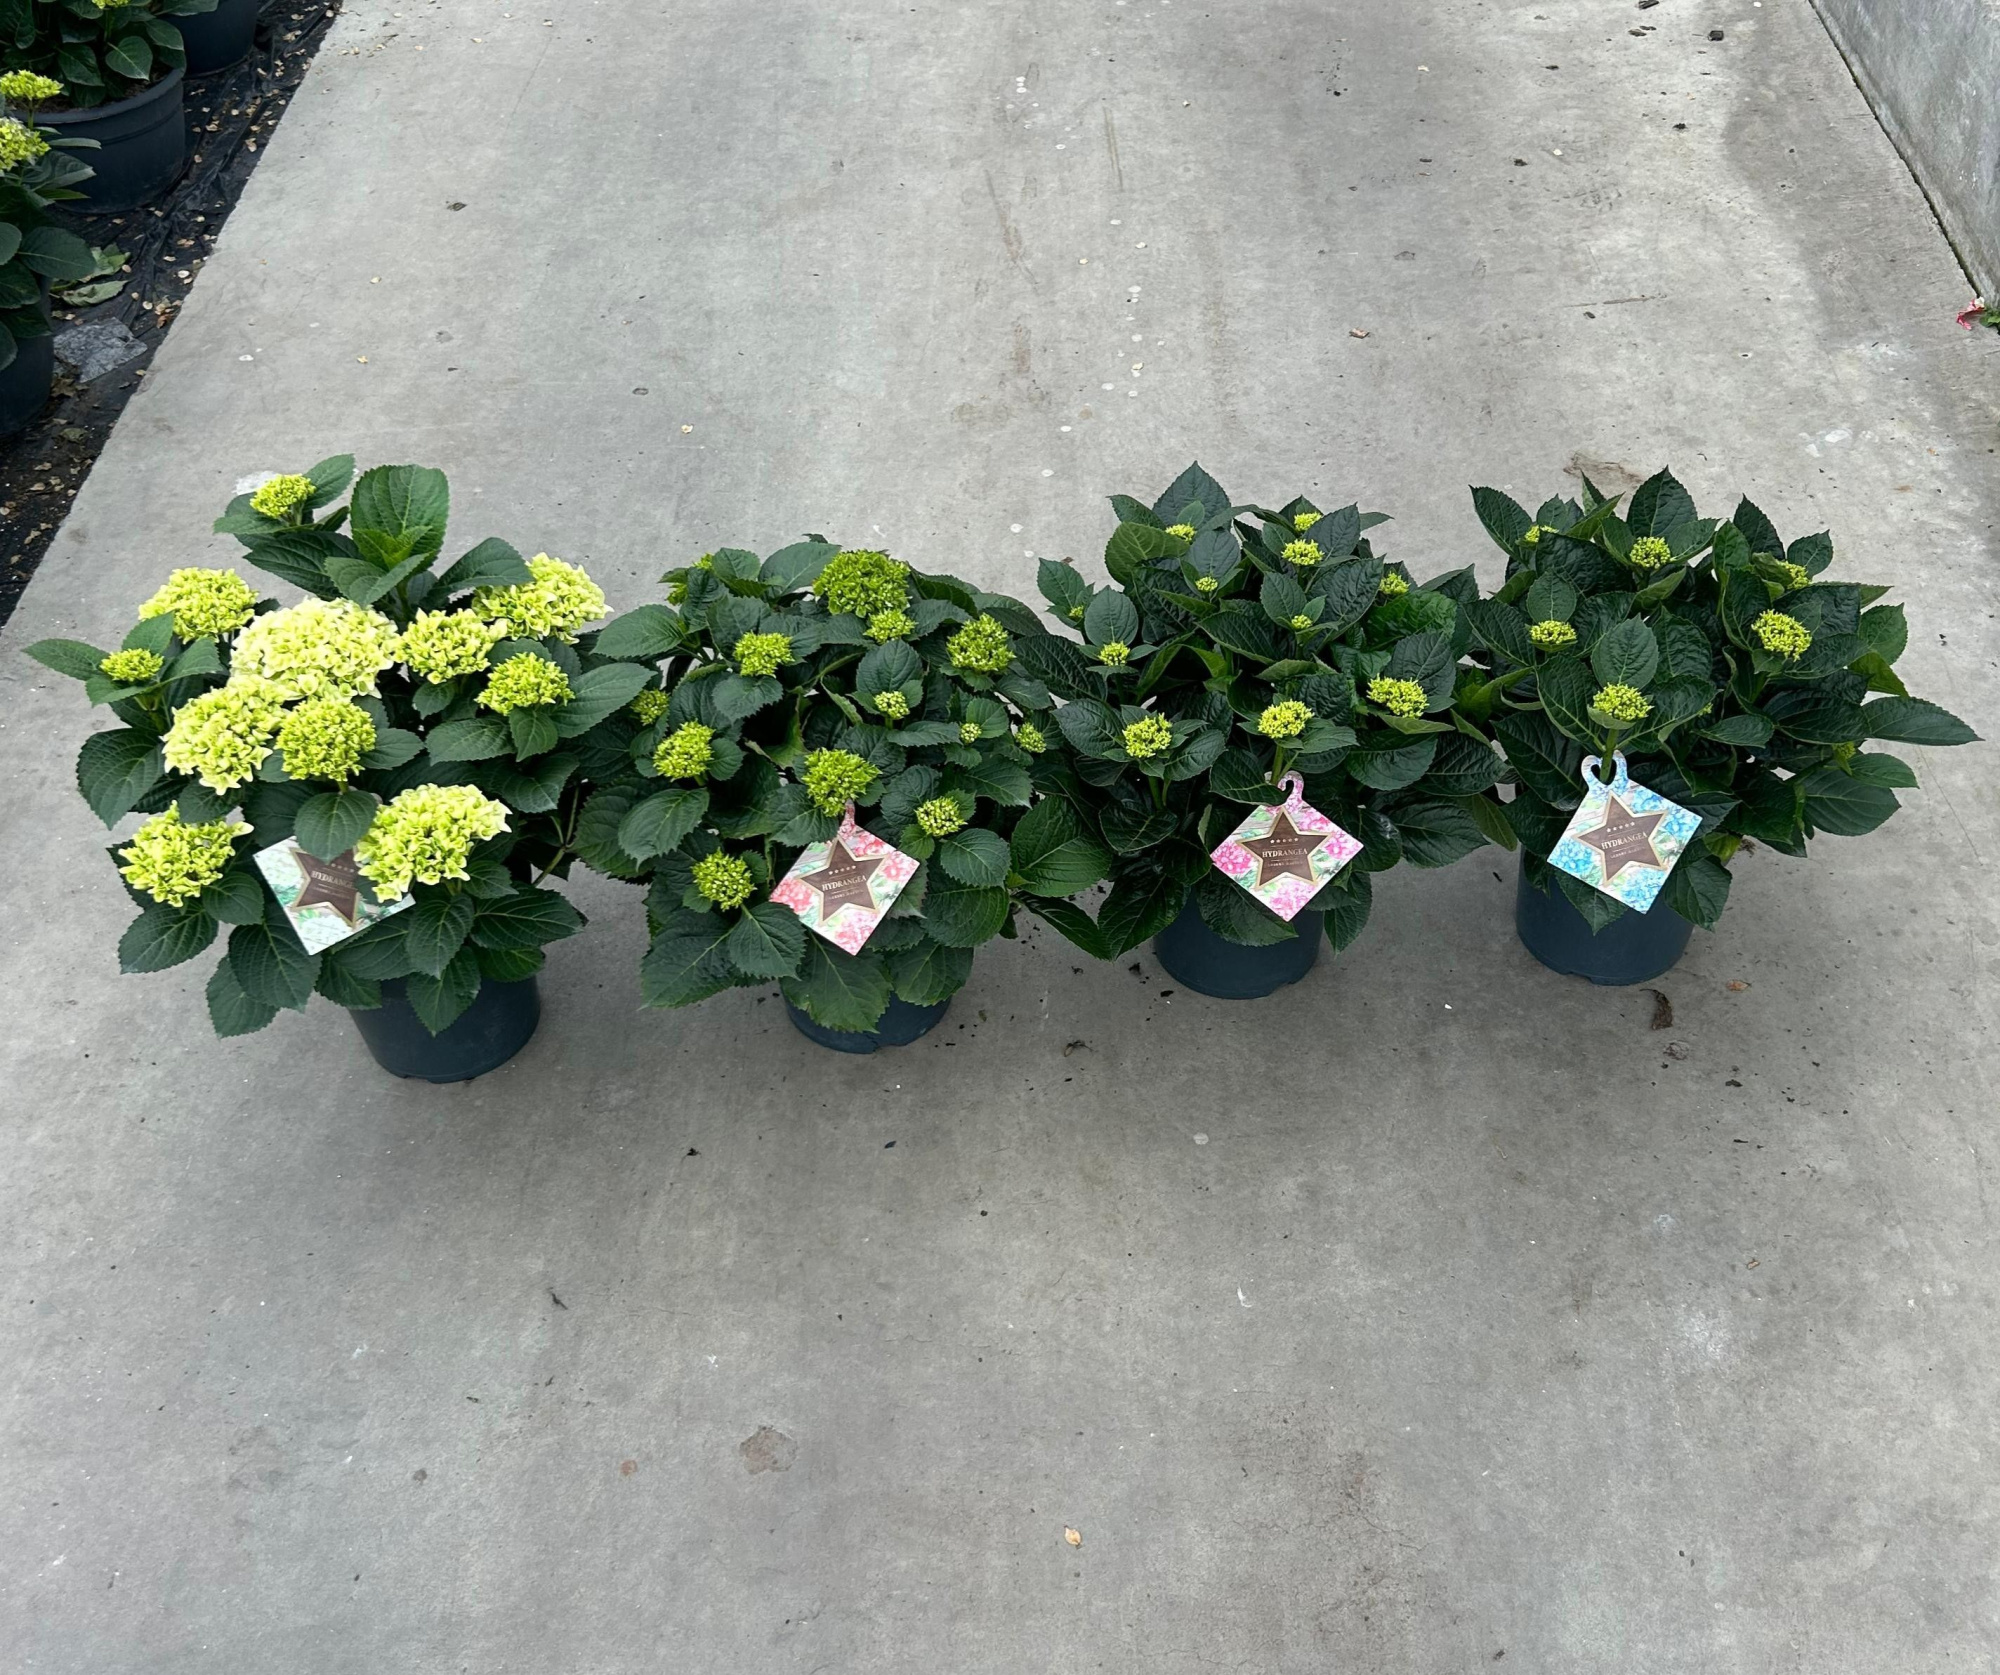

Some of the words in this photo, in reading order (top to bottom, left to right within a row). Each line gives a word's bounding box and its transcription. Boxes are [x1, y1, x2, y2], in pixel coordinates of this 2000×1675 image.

[1601, 831, 1647, 849] HYDRANGEA
[1262, 848, 1308, 858] HYDRANGEA
[821, 875, 867, 891] HYDRANGEA
